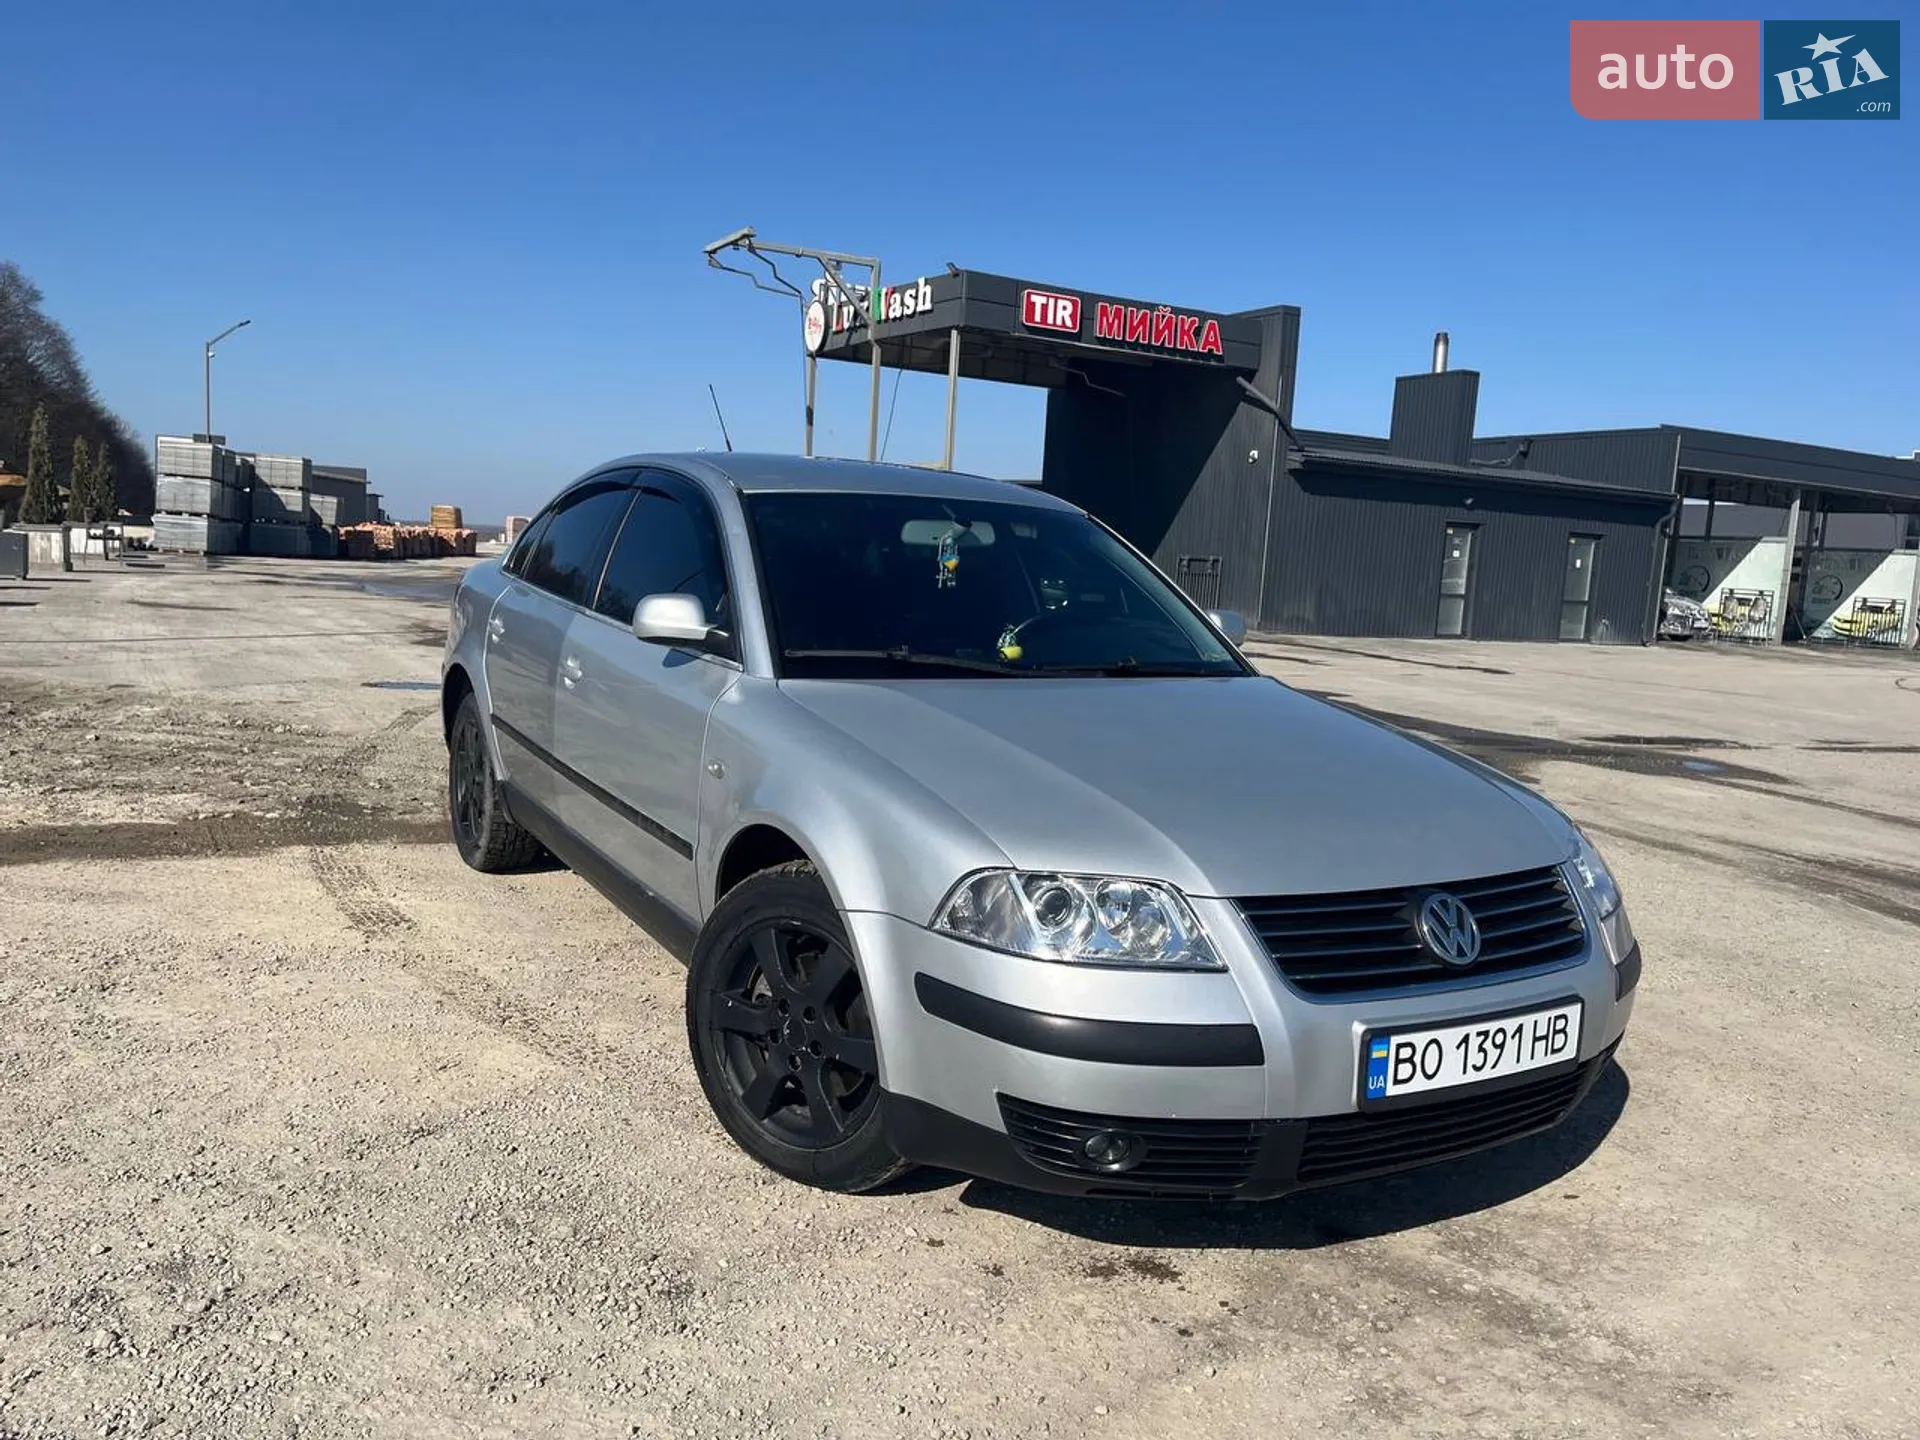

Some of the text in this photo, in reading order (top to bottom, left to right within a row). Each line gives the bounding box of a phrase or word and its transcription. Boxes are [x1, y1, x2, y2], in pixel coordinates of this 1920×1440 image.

[1028, 293, 1075, 329] TIR
[1096, 301, 1224, 354] МИЙКА
[1392, 1013, 1569, 1086] BO 1391 HB
[1368, 1074, 1385, 1090] UA
